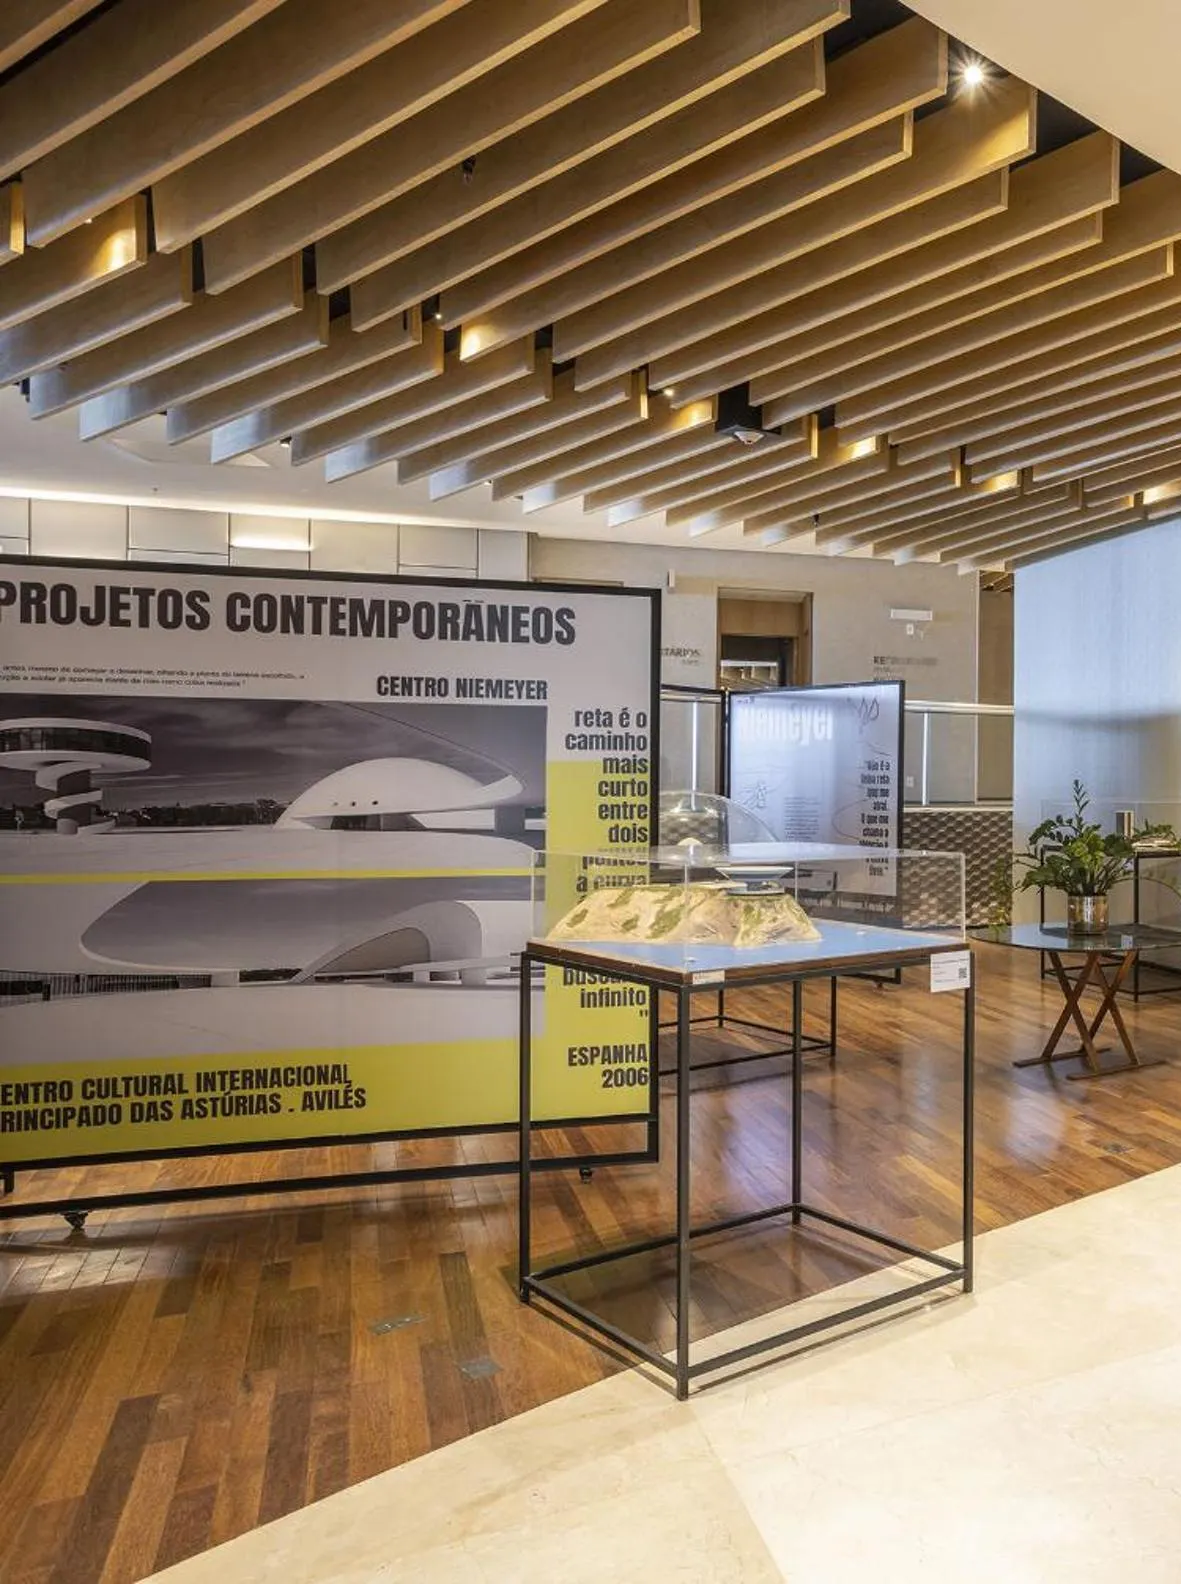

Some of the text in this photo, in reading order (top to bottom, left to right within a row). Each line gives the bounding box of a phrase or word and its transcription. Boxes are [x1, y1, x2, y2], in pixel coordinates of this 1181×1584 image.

[0, 580, 576, 645] PROJETOS CONTEMPORÂNEOS
[376, 675, 548, 700] CENTRO NIEMEYER
[574, 708, 648, 728] reta é o
[565, 731, 648, 750] caminho
[602, 755, 649, 774] mais
[598, 779, 648, 797] curto
[598, 802, 648, 820] entre
[608, 824, 649, 843] dois
[581, 987, 647, 1008] infinito
[568, 1043, 648, 1066] ESPANHA
[81, 1073, 188, 1100] CULTURAL
[196, 1064, 353, 1092] INTERNACIONAL
[602, 1067, 649, 1088] 2006
[130, 1100, 173, 1124] DAS
[181, 1091, 281, 1120] ASTÚRIAS
[302, 1085, 366, 1113] AVILÉS
